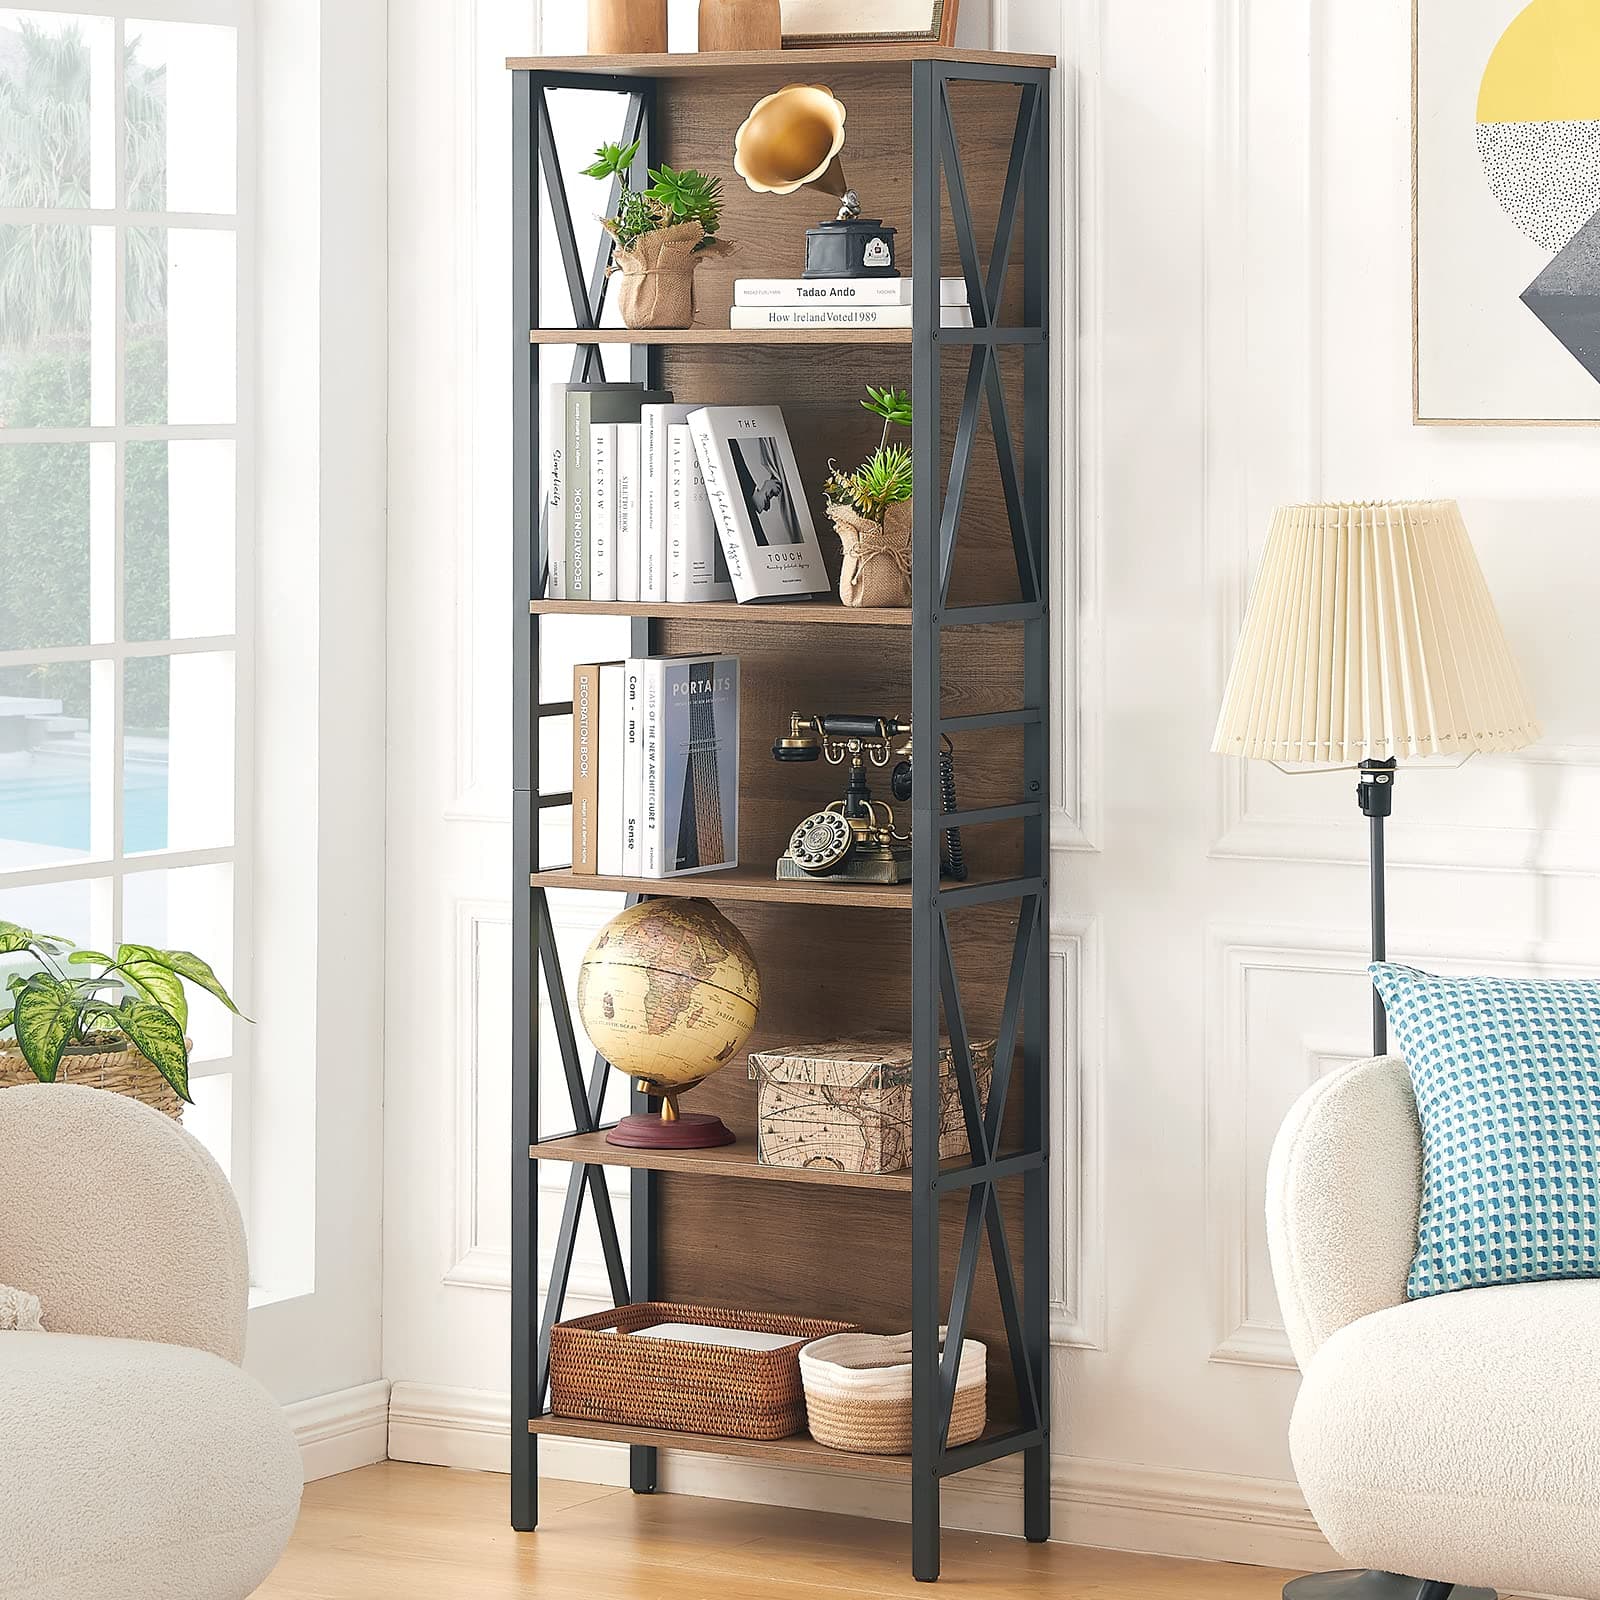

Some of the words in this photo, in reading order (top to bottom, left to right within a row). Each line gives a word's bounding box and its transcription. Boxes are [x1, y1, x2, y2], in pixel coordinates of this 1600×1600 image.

[796, 287, 827, 297] Tadao
[829, 287, 856, 297] Ando
[768, 312, 790, 322] How
[793, 312, 877, 322] IrelandVoted1989
[737, 419, 757, 428] THE
[550, 449, 562, 508] Simplicity
[574, 487, 583, 520] BOOK
[574, 521, 583, 590] DECORATION
[767, 552, 803, 562] TOUCH
[629, 675, 637, 700] Com
[580, 676, 589, 744] DECORATION
[648, 711, 656, 722] OF
[648, 725, 656, 739] THE
[580, 746, 589, 778] BOOK
[648, 742, 656, 761] NEW
[628, 818, 636, 850] Sense
